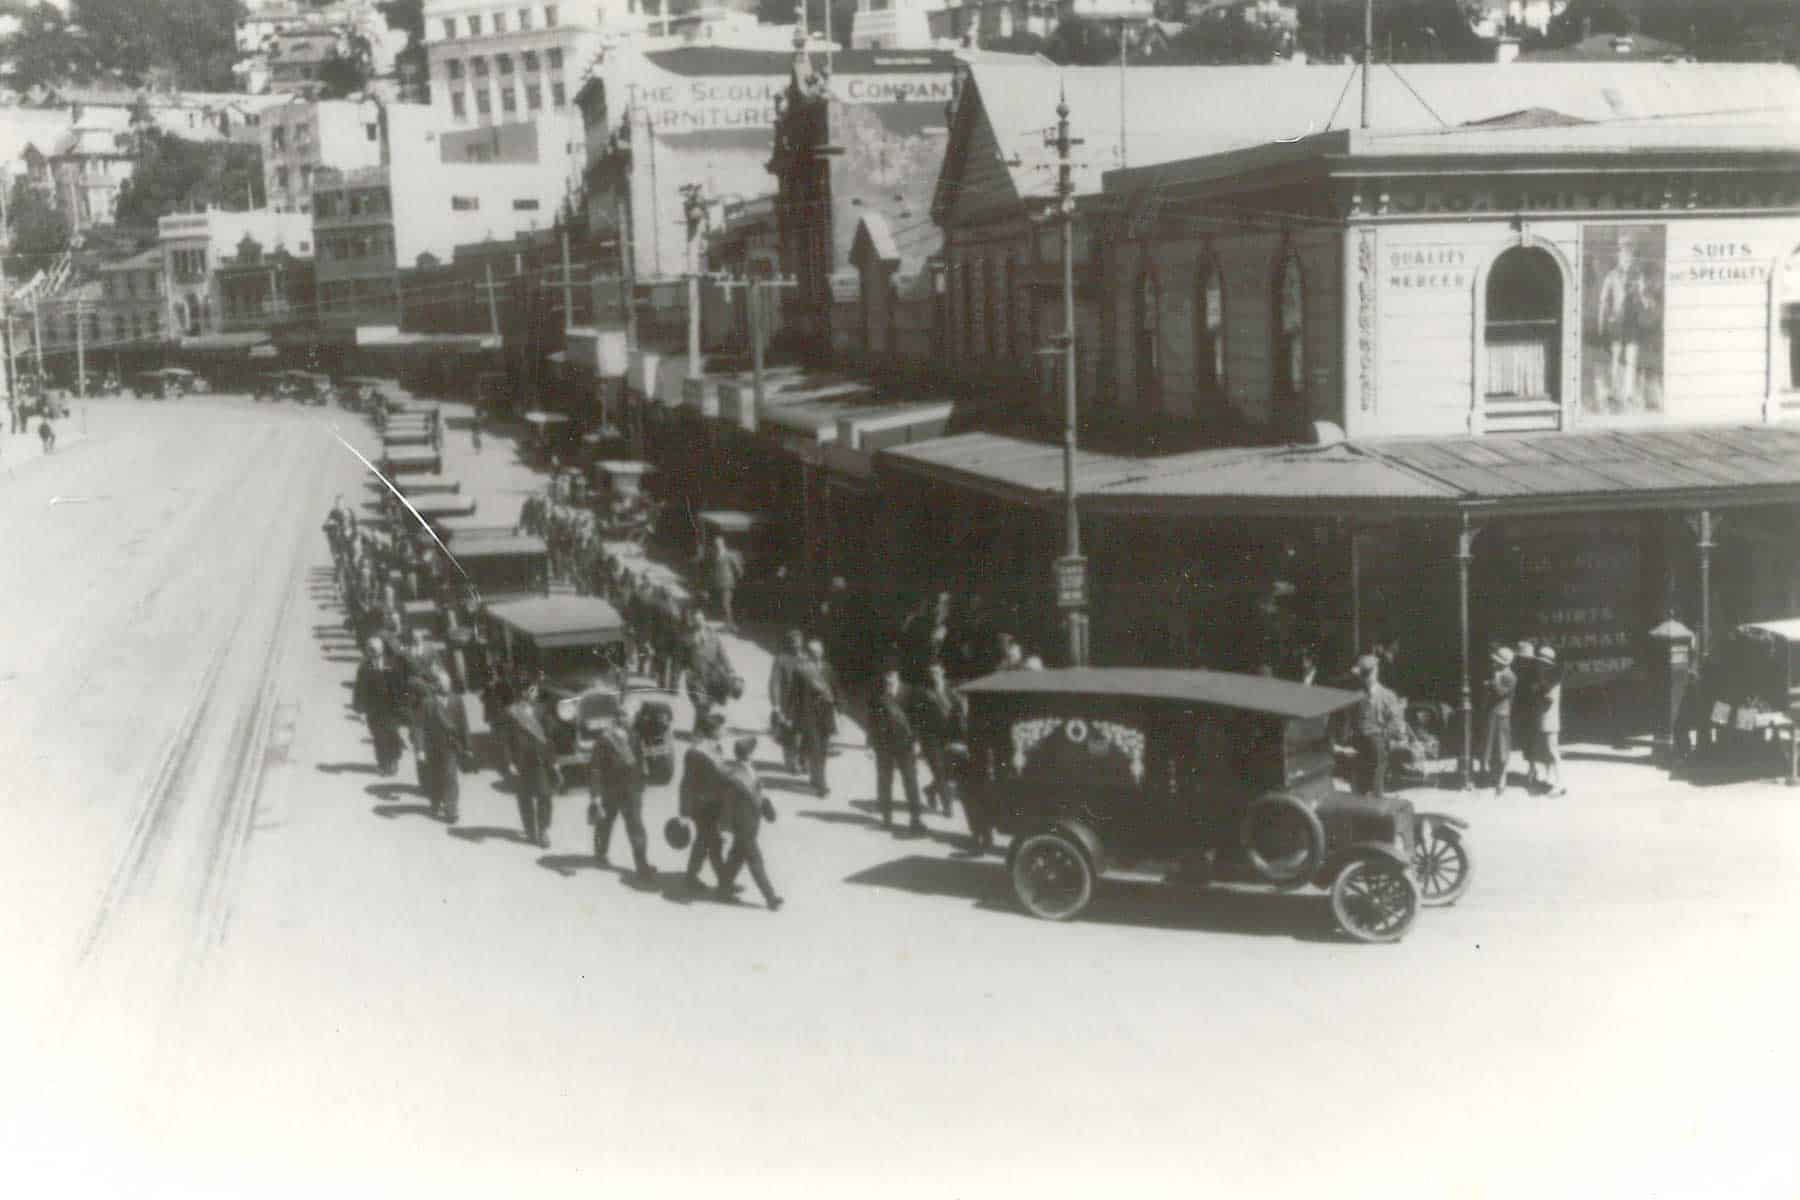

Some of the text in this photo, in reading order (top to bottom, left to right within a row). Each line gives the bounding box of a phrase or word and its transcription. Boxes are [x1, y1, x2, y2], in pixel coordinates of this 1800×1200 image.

[1691, 242, 1752, 257] SUITS
[1390, 250, 1465, 266] QUALITY
[1689, 264, 1767, 281] SPECIALTY
